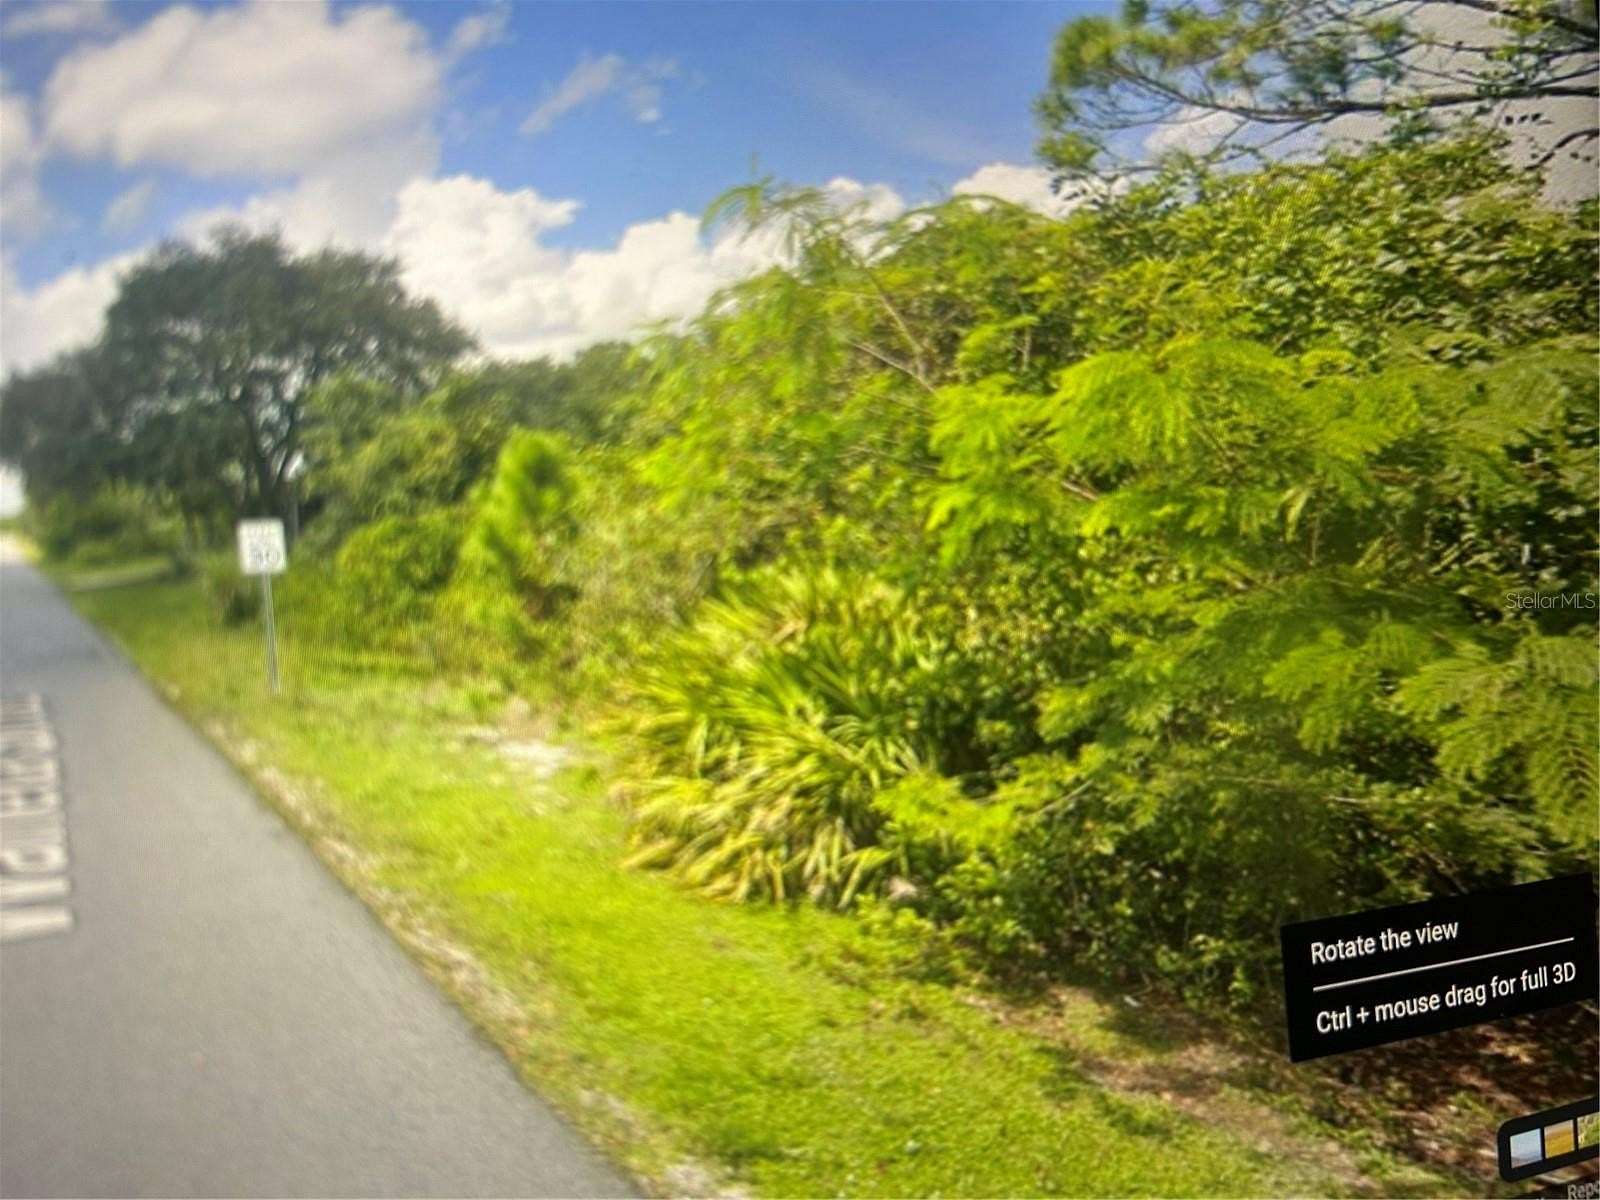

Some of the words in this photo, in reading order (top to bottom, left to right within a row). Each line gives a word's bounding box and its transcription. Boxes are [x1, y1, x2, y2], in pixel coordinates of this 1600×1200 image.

[1311, 936, 1376, 965] Rotate
[1381, 928, 1412, 951] the
[1415, 921, 1458, 945] view
[1316, 1004, 1351, 1034] Ctrl
[1356, 1009, 1370, 1025] +
[1375, 992, 1440, 1022] mouse
[1444, 983, 1486, 1007] drag
[1491, 975, 1516, 998] for
[1520, 967, 1548, 992] full
[1552, 961, 1577, 984] 3D
